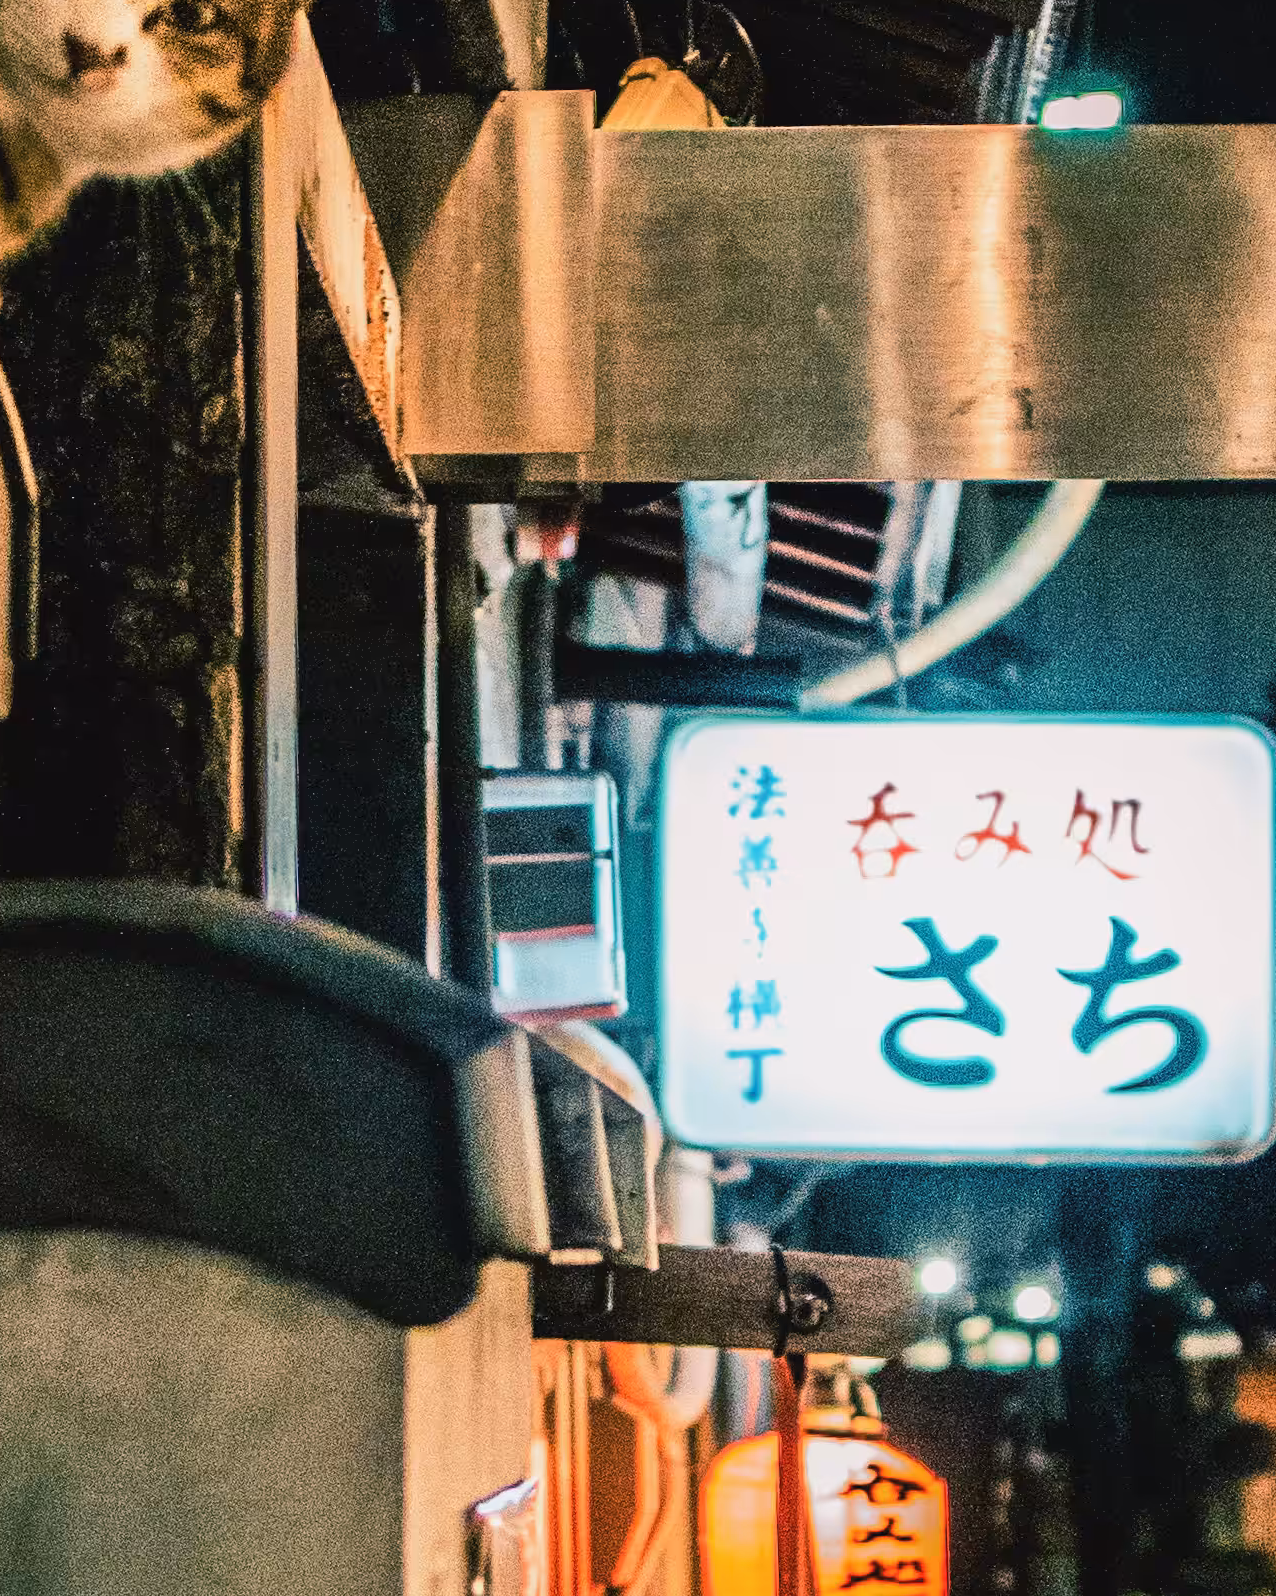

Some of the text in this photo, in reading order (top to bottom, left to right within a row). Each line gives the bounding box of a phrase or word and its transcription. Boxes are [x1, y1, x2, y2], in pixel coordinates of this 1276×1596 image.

[846, 781, 1151, 880] 呑み処
[872, 915, 1210, 1095] さち
